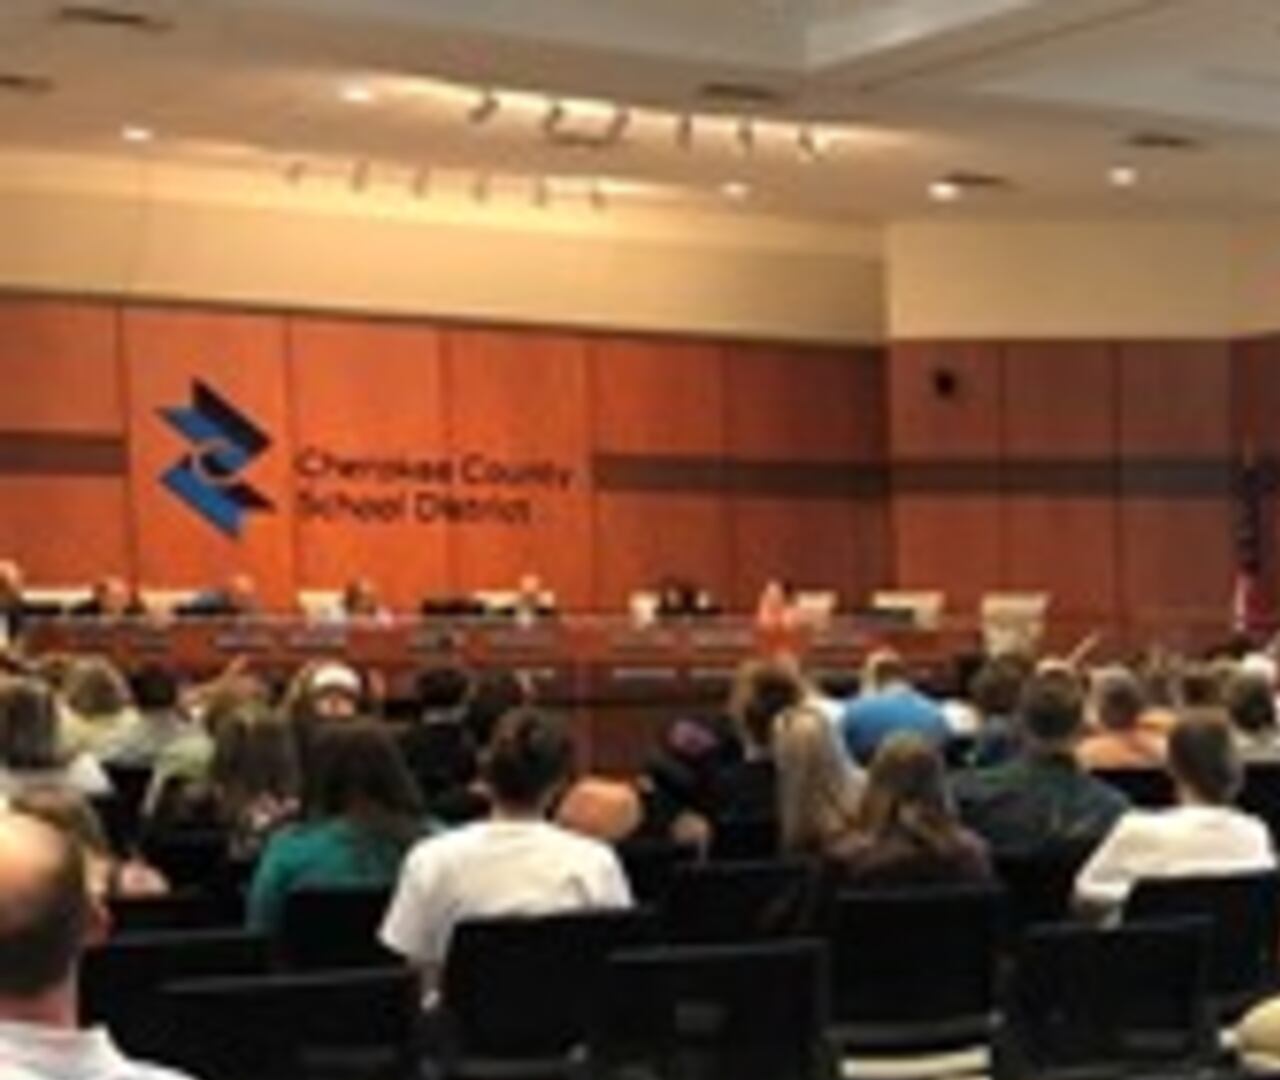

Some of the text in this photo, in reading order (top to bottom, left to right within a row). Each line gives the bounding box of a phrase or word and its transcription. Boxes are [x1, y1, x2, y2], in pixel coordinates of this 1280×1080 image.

[293, 447, 571, 491] Cherokee County
[297, 490, 531, 524] School District
